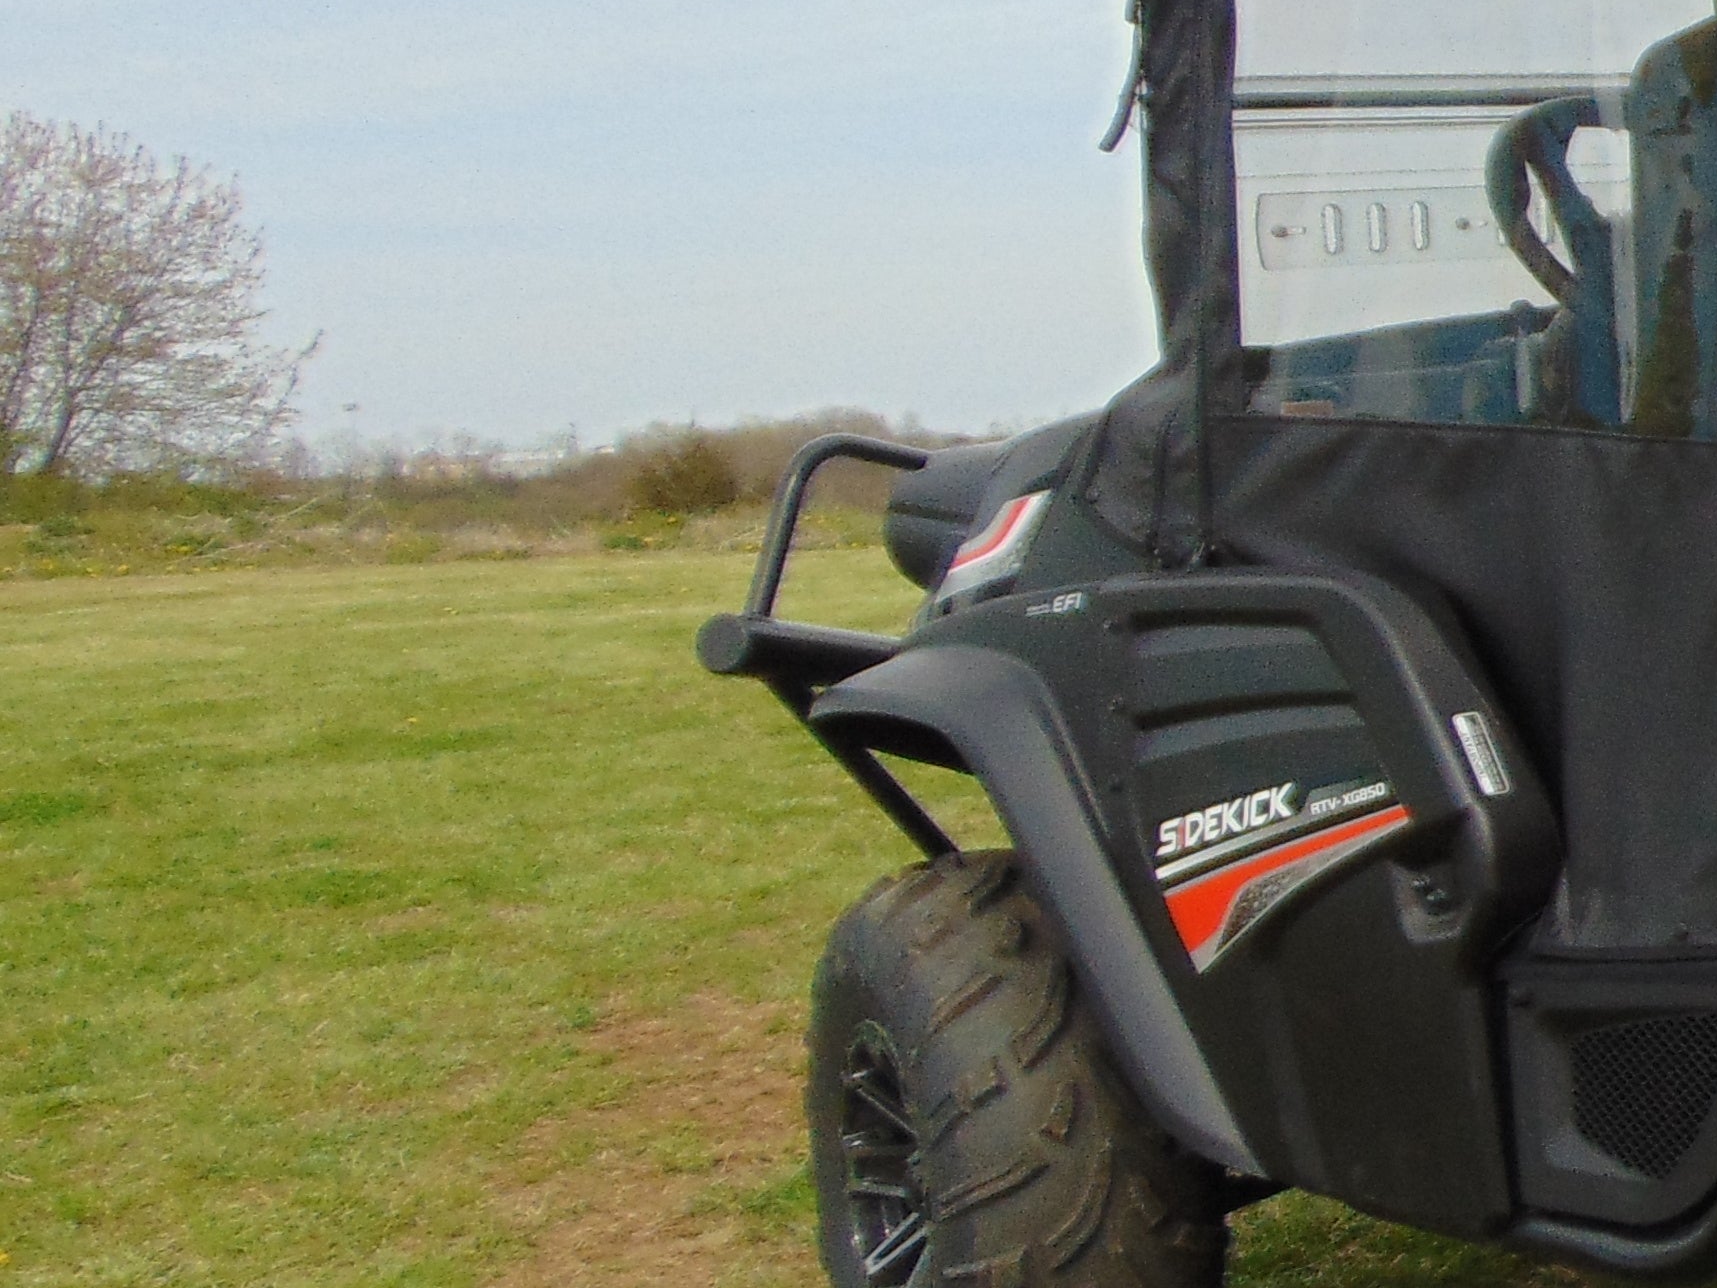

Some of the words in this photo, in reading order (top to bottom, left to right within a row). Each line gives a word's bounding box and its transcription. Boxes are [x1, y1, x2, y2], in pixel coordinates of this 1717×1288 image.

[1052, 592, 1083, 613] EFI
[1156, 781, 1295, 857] SIDEKICK
[1310, 781, 1387, 816] RTV-XG850
